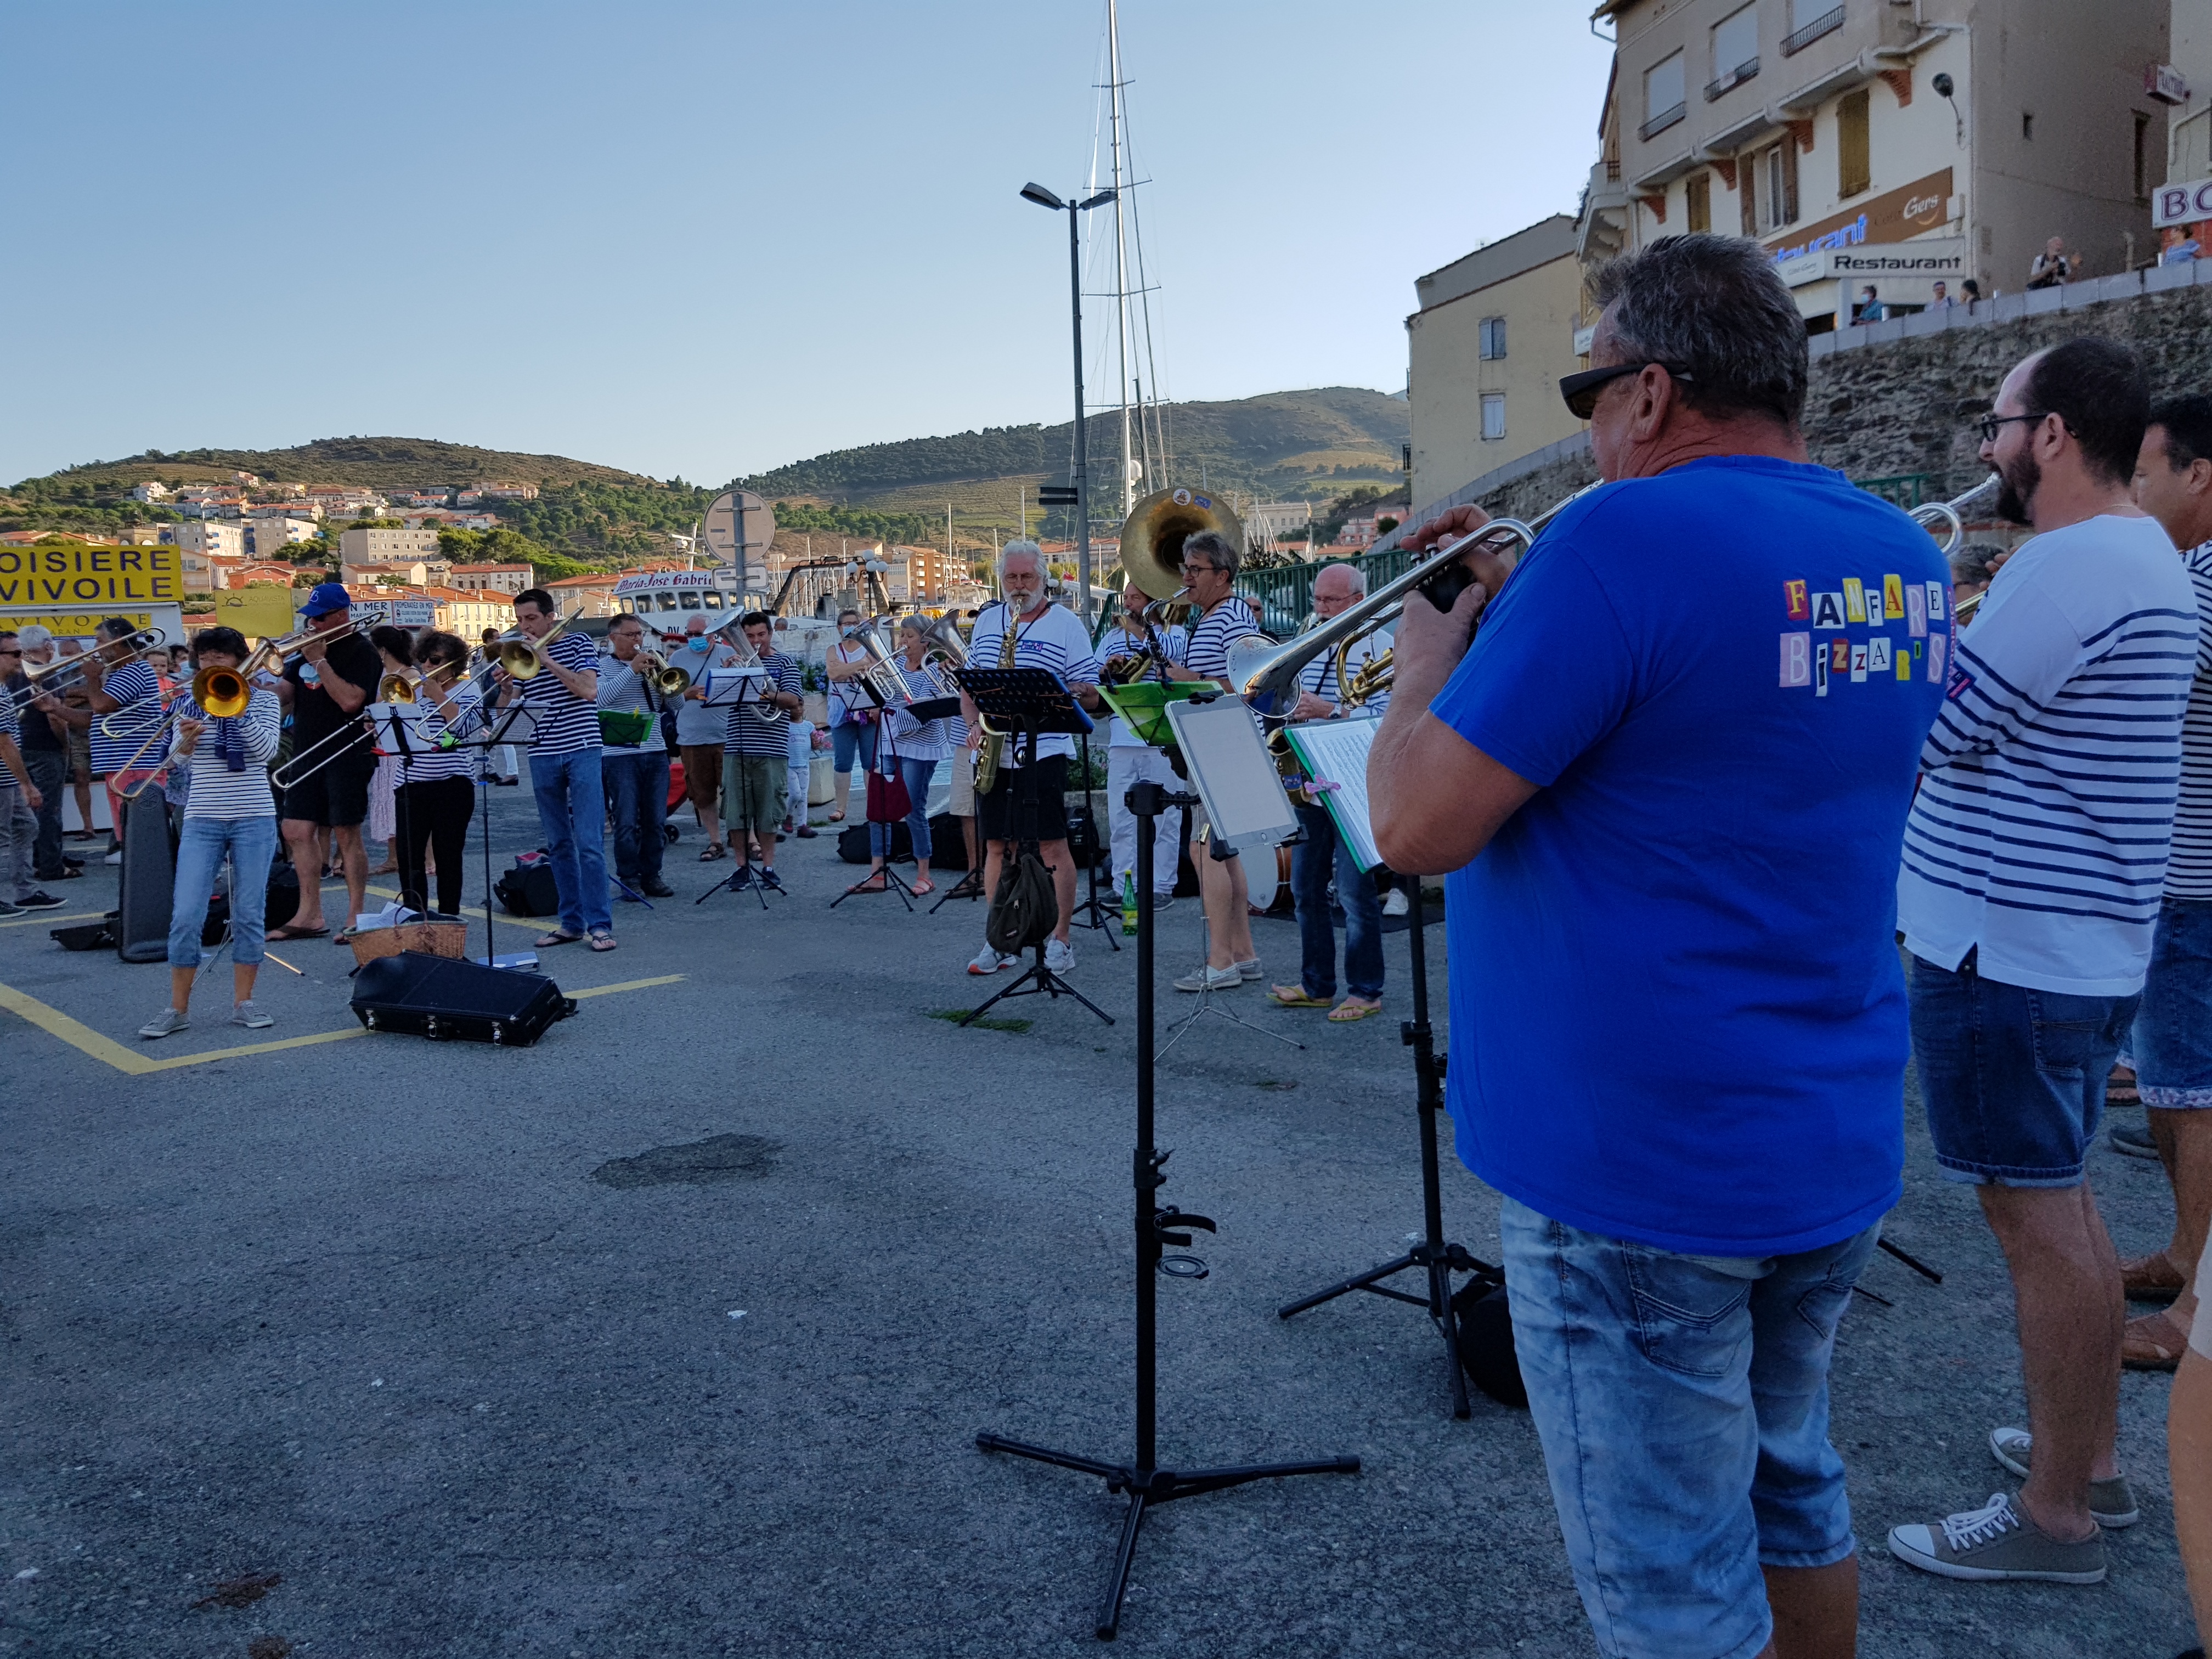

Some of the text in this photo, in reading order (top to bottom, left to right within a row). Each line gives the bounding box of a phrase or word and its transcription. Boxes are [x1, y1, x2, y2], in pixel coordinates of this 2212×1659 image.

[1834, 255, 1961, 269] Restaurant
[0, 551, 171, 573] OISIERE
[0, 577, 173, 601] VIVOILE
[364, 602, 388, 611] MER
[1786, 580, 1940, 634] FANFARE
